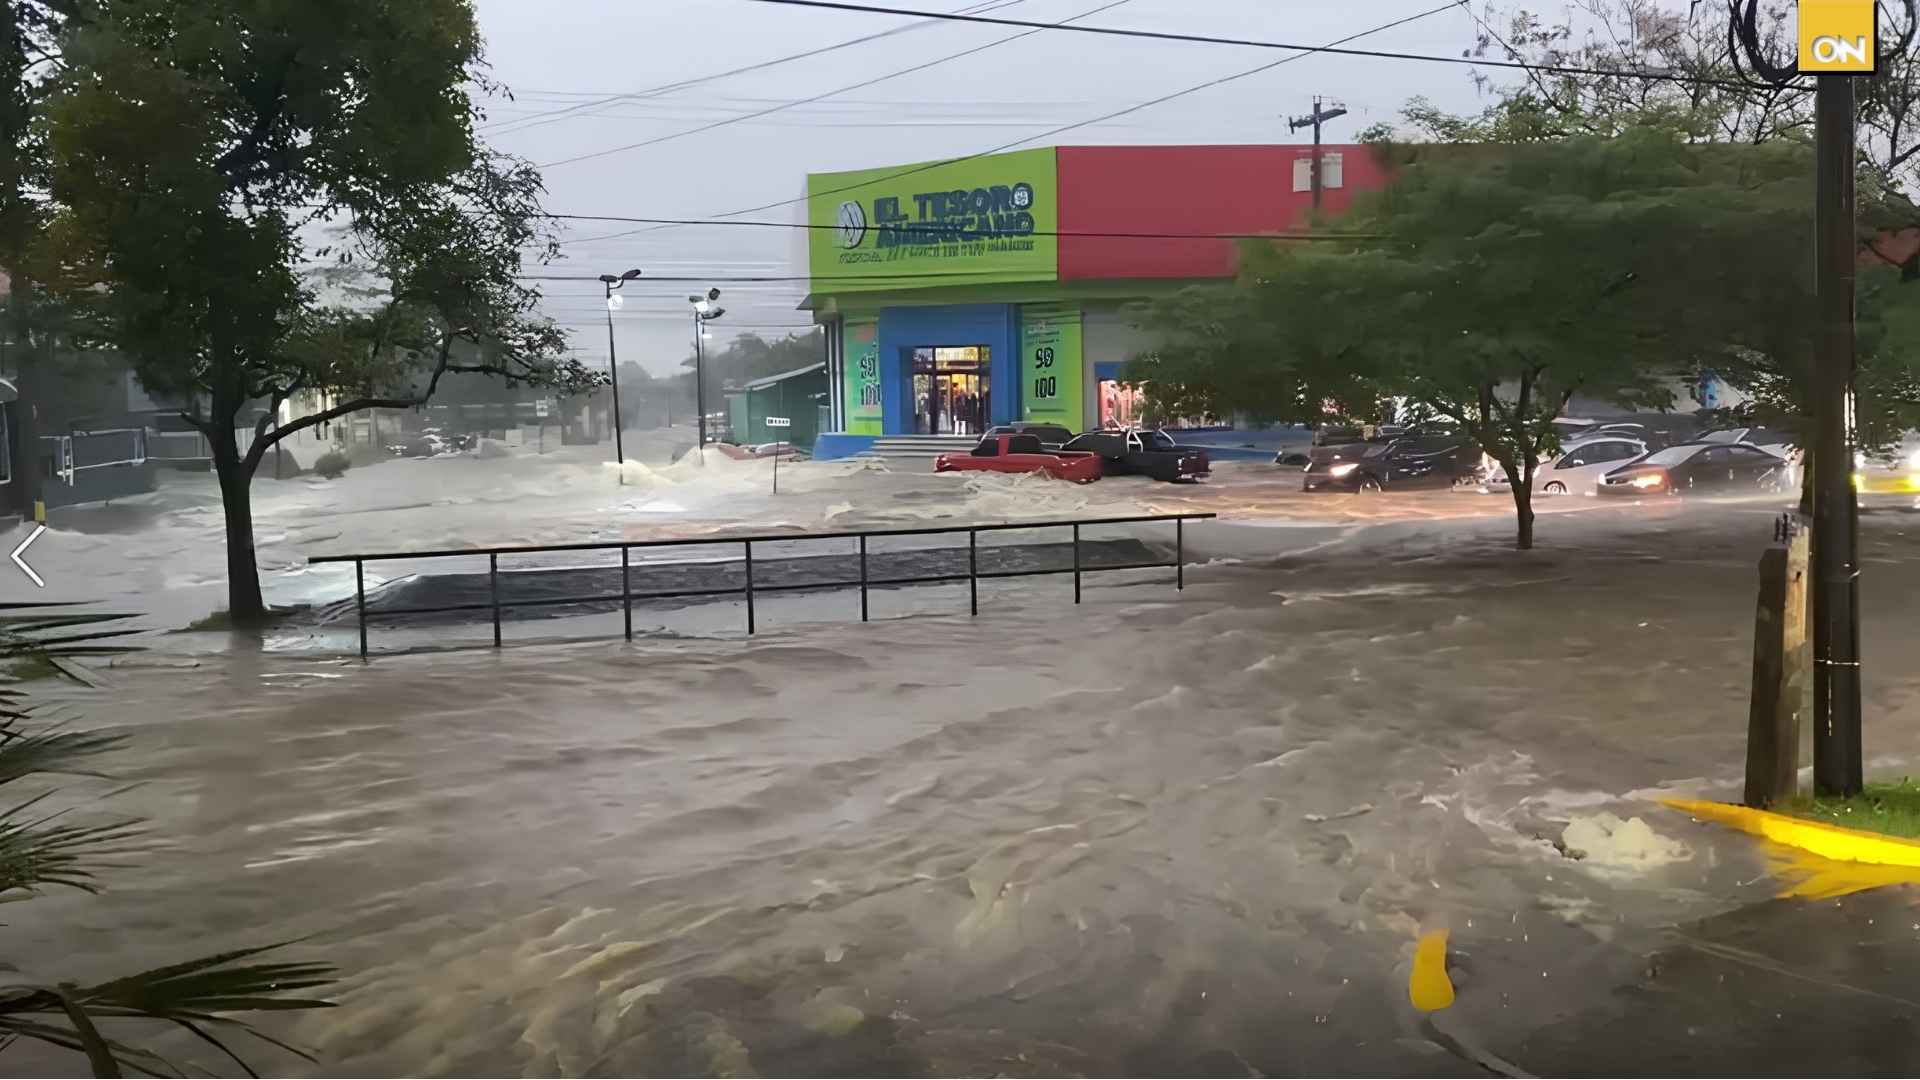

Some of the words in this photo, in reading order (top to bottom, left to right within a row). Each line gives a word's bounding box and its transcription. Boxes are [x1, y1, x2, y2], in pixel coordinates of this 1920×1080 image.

[874, 196, 908, 224] EL
[913, 182, 1034, 222] TESORO
[1035, 376, 1056, 398] 100
